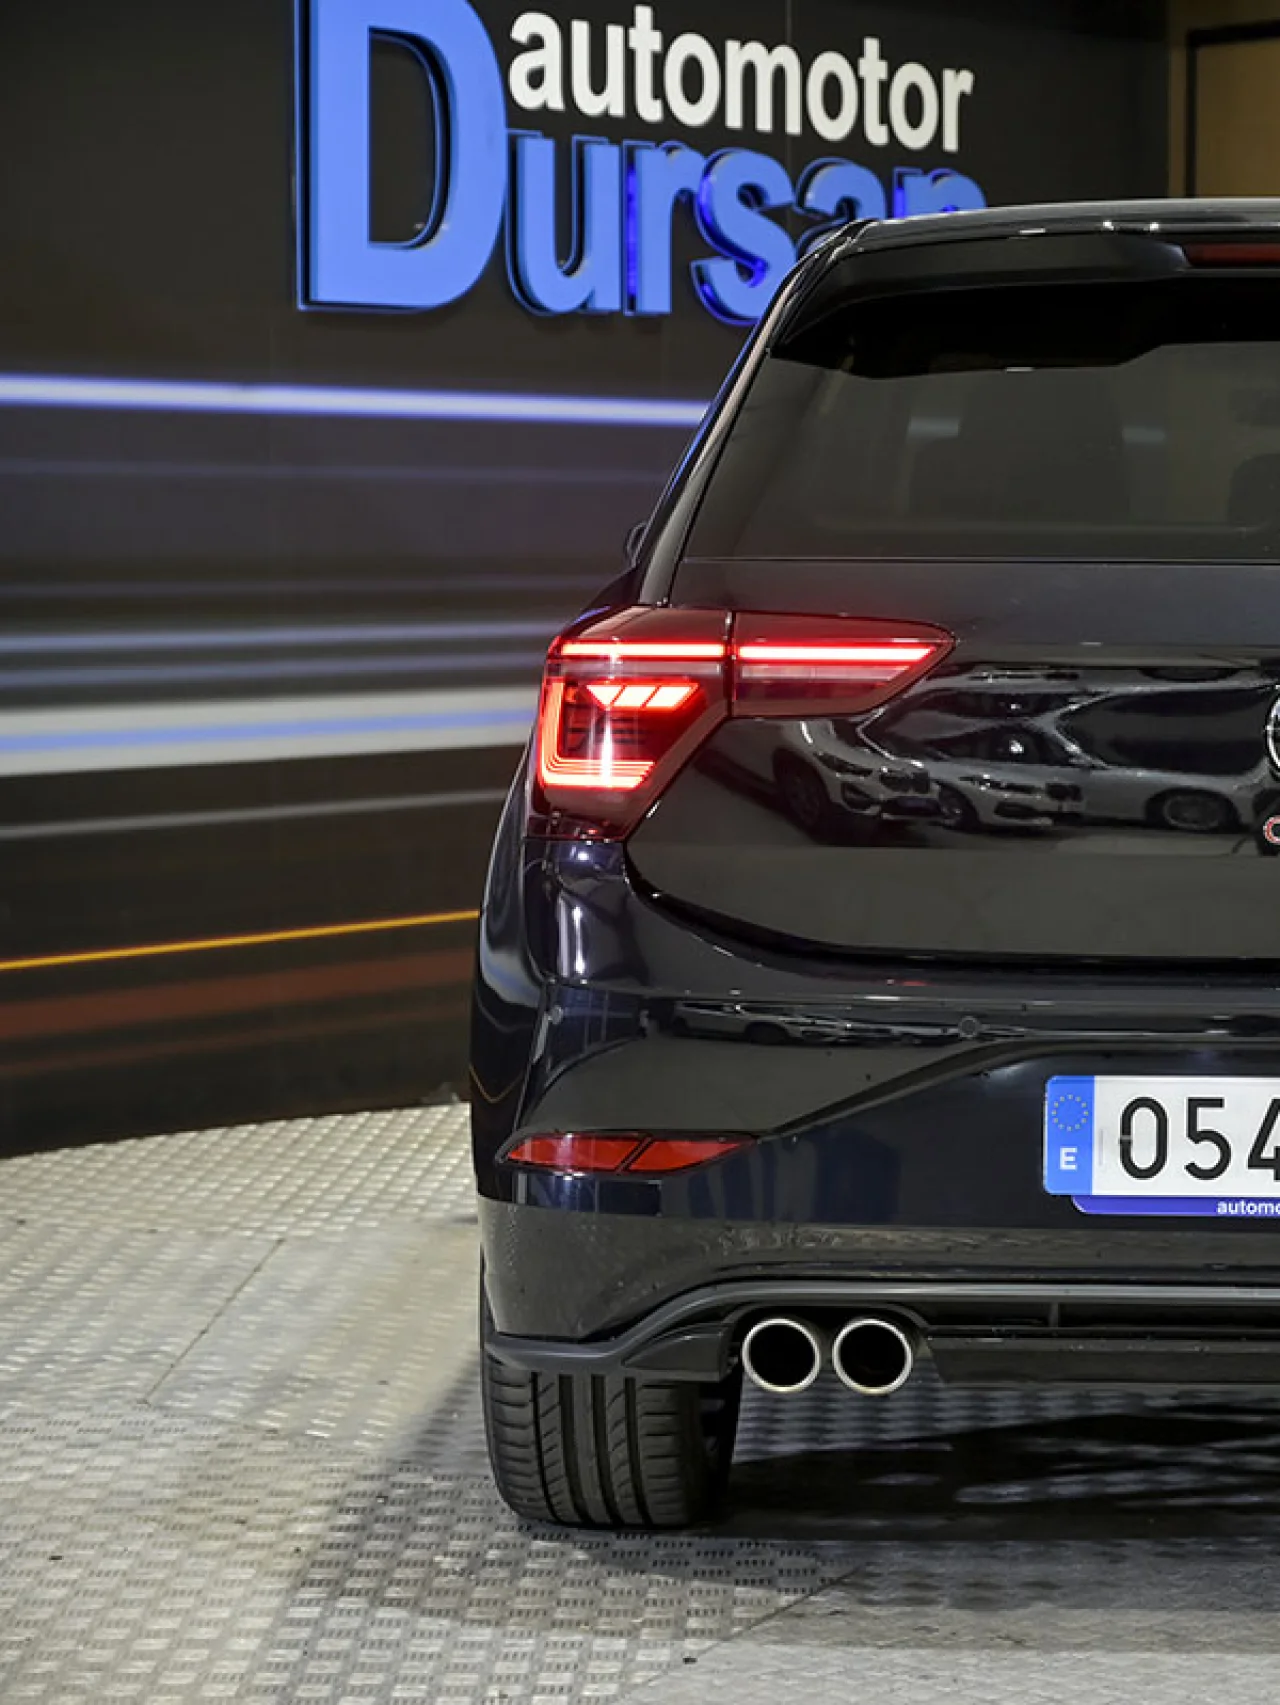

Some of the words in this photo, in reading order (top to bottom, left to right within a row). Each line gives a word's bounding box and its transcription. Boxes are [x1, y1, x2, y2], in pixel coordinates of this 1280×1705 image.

[510, 5, 973, 151] automotor
[297, 0, 988, 325] Durs
[1059, 1147, 1077, 1170] E
